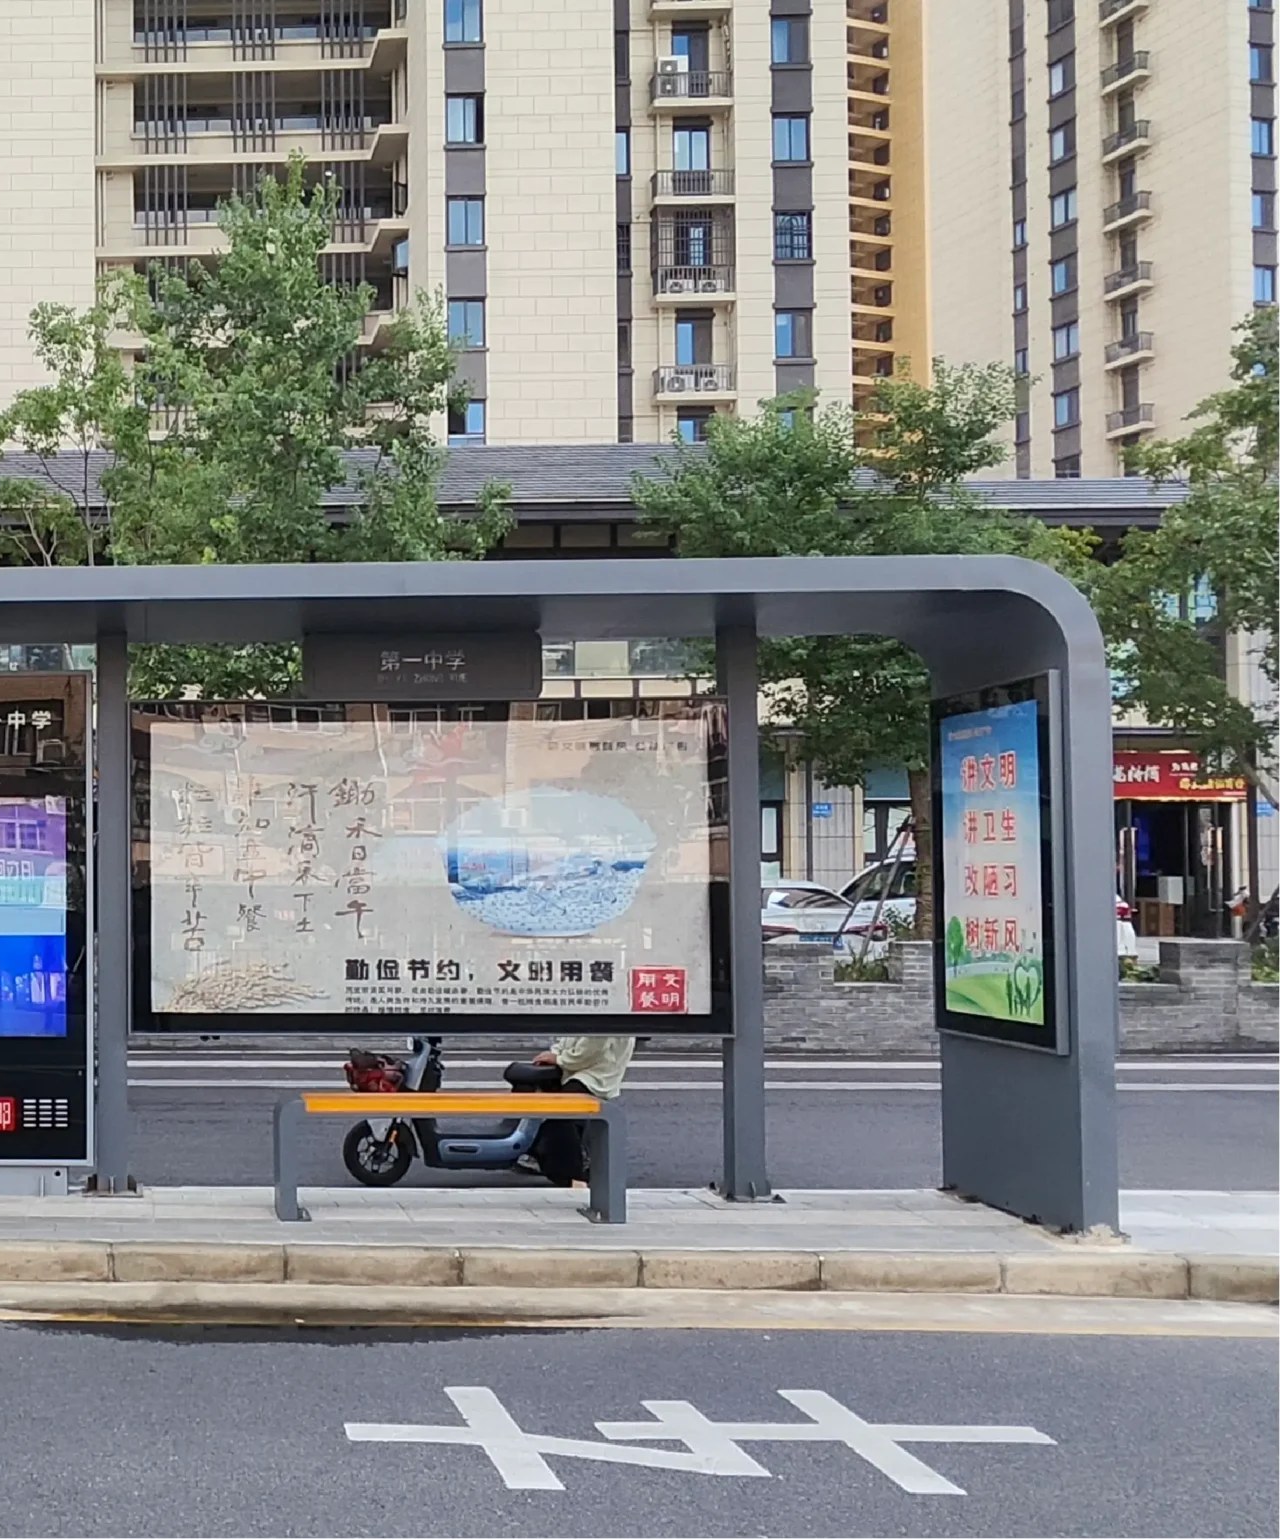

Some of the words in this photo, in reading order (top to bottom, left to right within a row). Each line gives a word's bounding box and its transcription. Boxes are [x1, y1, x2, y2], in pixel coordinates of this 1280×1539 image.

[380, 650, 467, 671] 第一中学
[960, 750, 1017, 794] 讲文明
[963, 809, 1017, 844] 讲卫生
[964, 865, 1018, 898] 改陋习
[965, 916, 1020, 954] 树新风
